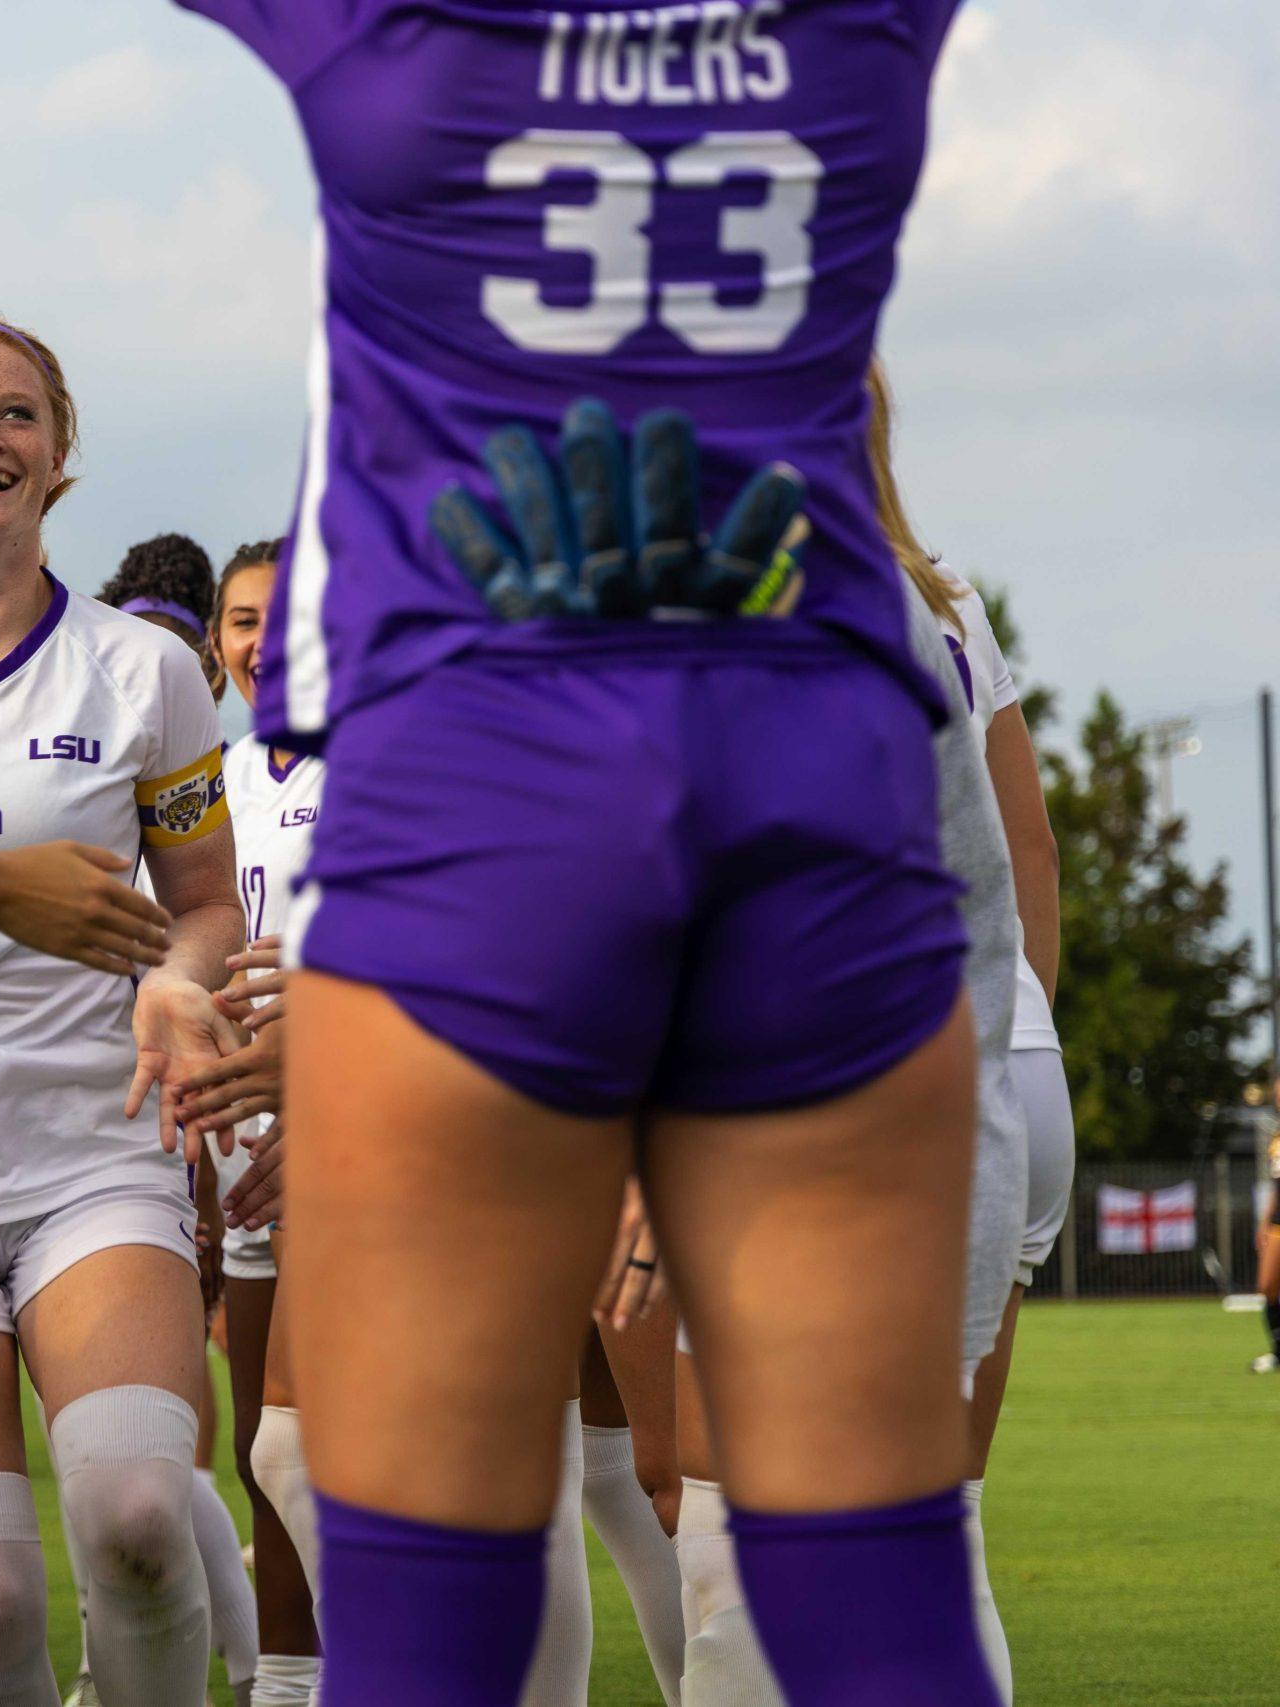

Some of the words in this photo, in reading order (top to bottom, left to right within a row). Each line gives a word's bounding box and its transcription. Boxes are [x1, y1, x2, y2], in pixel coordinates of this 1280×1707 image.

[482, 127, 825, 356] 33
[29, 735, 101, 764] LSU
[170, 780, 198, 797] LSU
[280, 805, 318, 828] LSU
